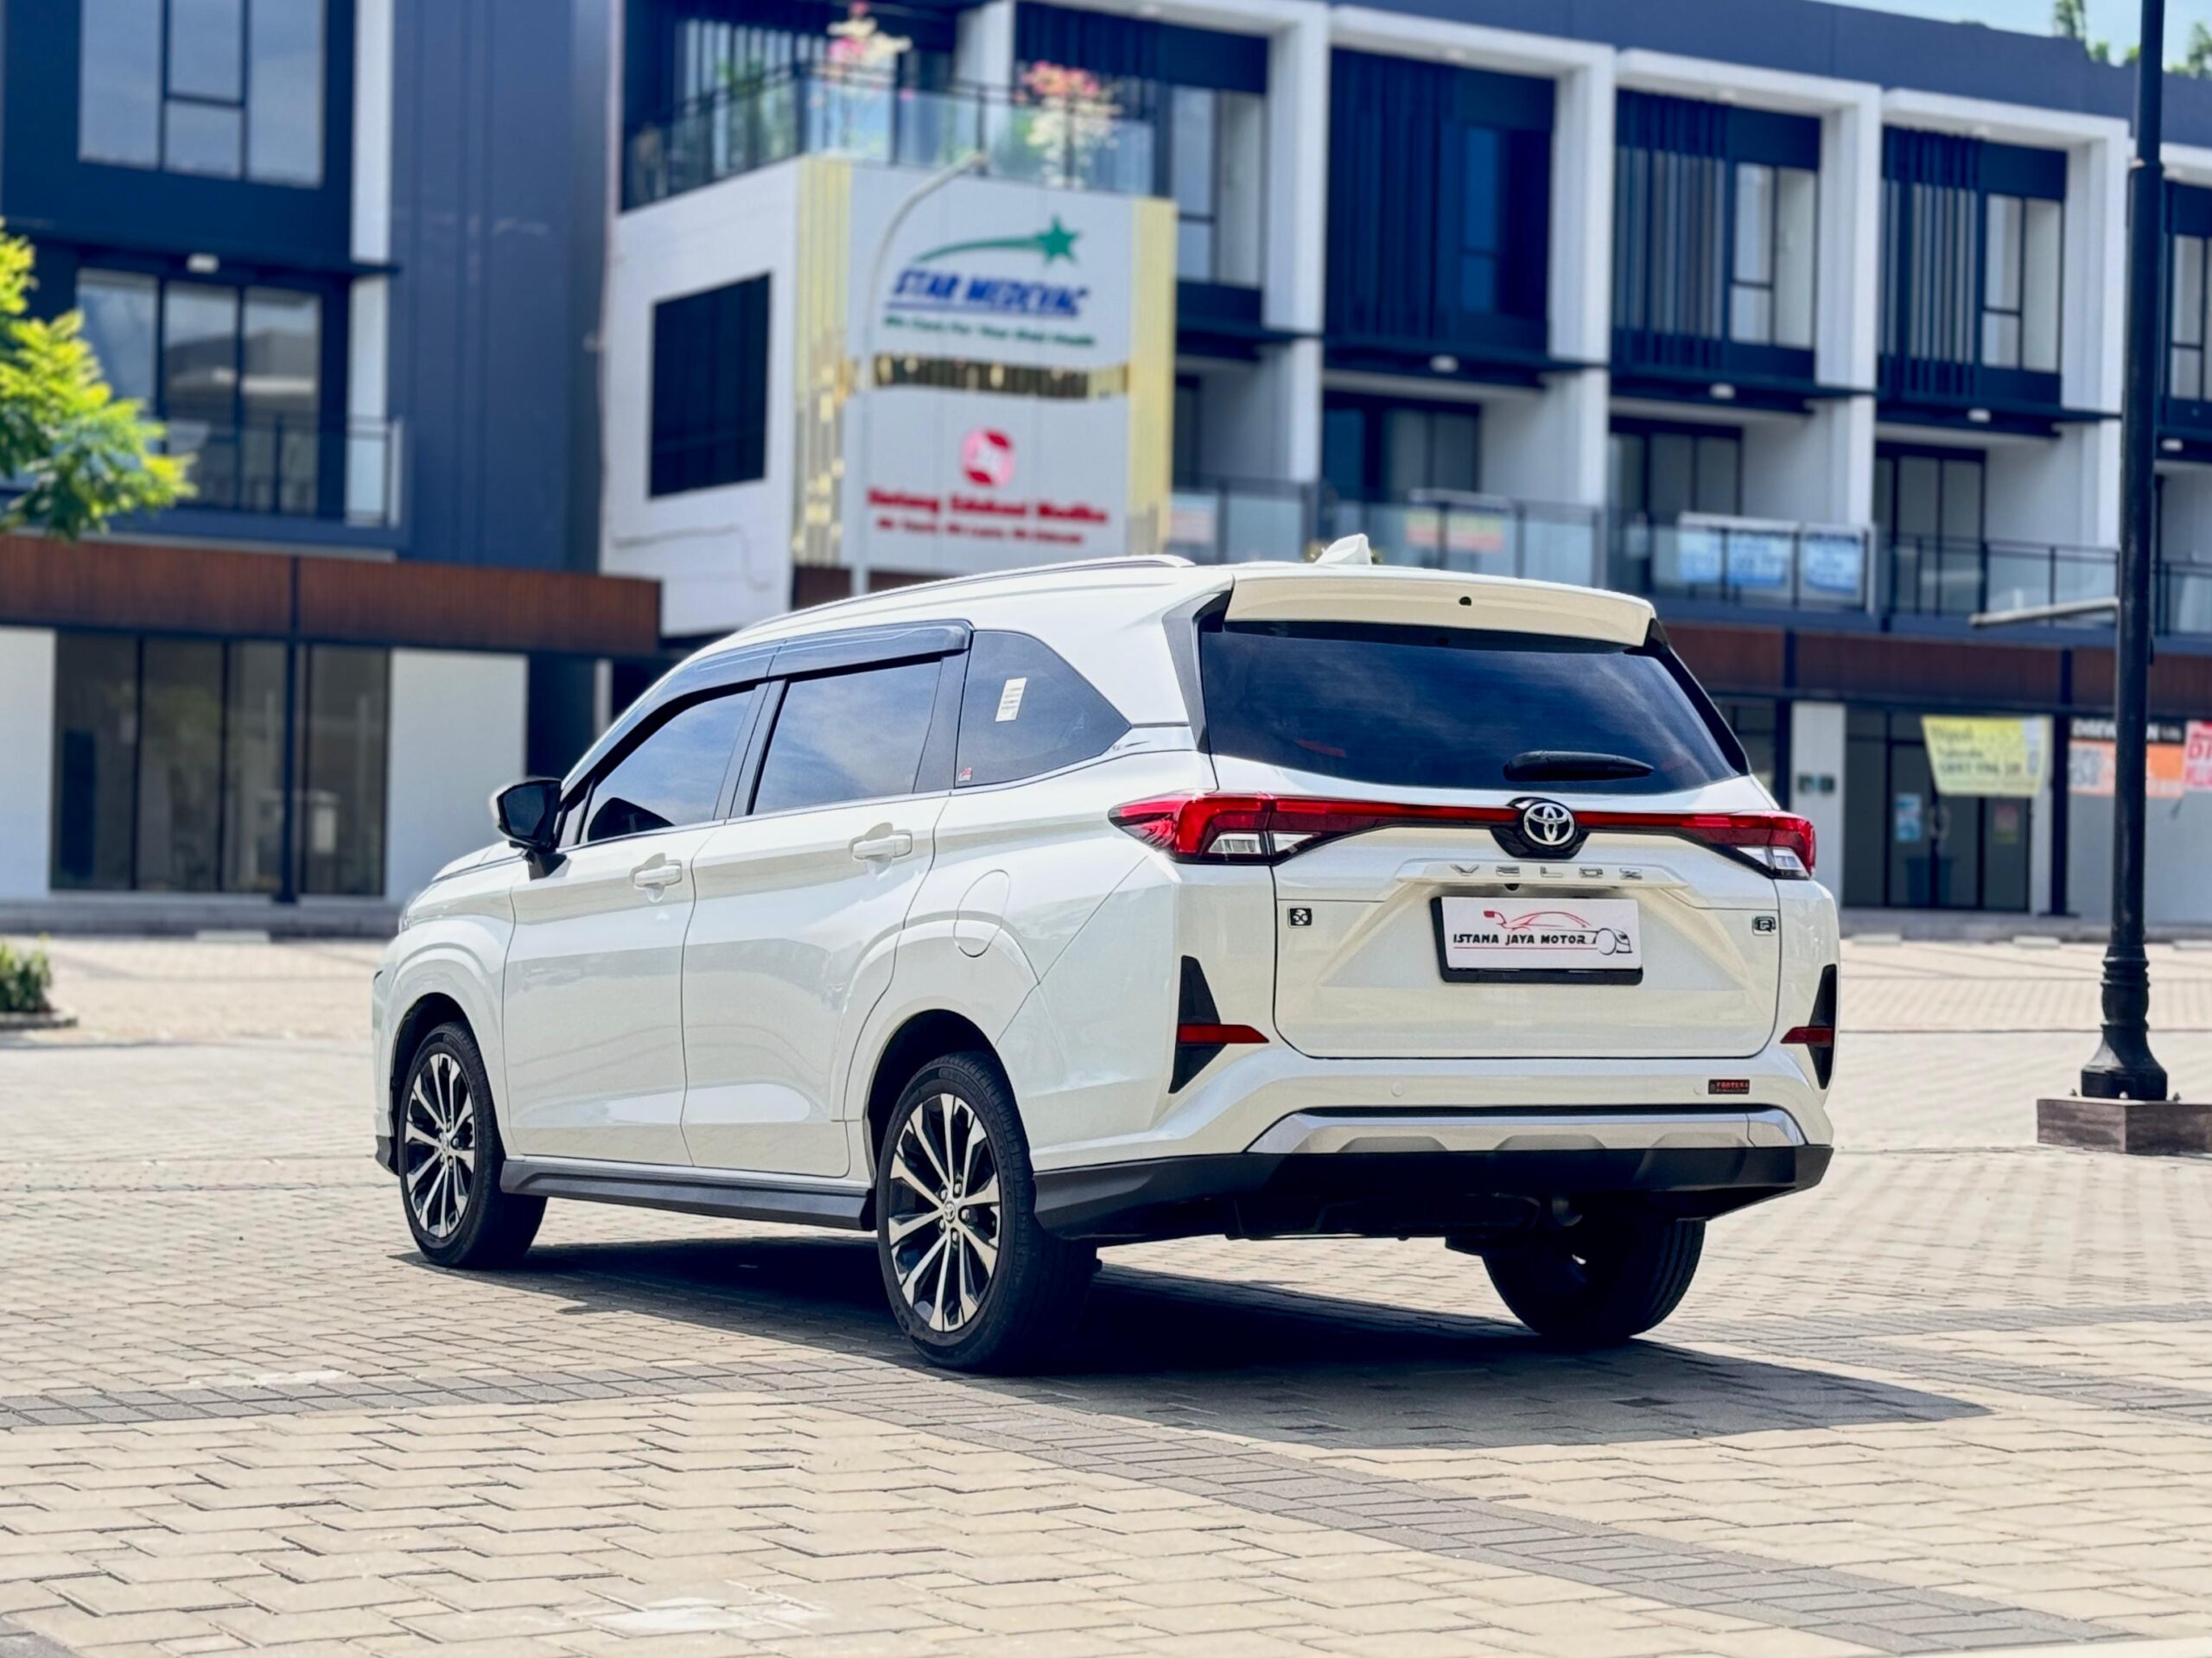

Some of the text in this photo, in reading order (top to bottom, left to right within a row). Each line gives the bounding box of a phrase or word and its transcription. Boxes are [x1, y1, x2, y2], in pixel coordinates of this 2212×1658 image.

[893, 270, 960, 298] STAR
[1450, 864, 1643, 880] VELOZ
[1452, 933, 1586, 946] ISTANA JAYA MOTOR
